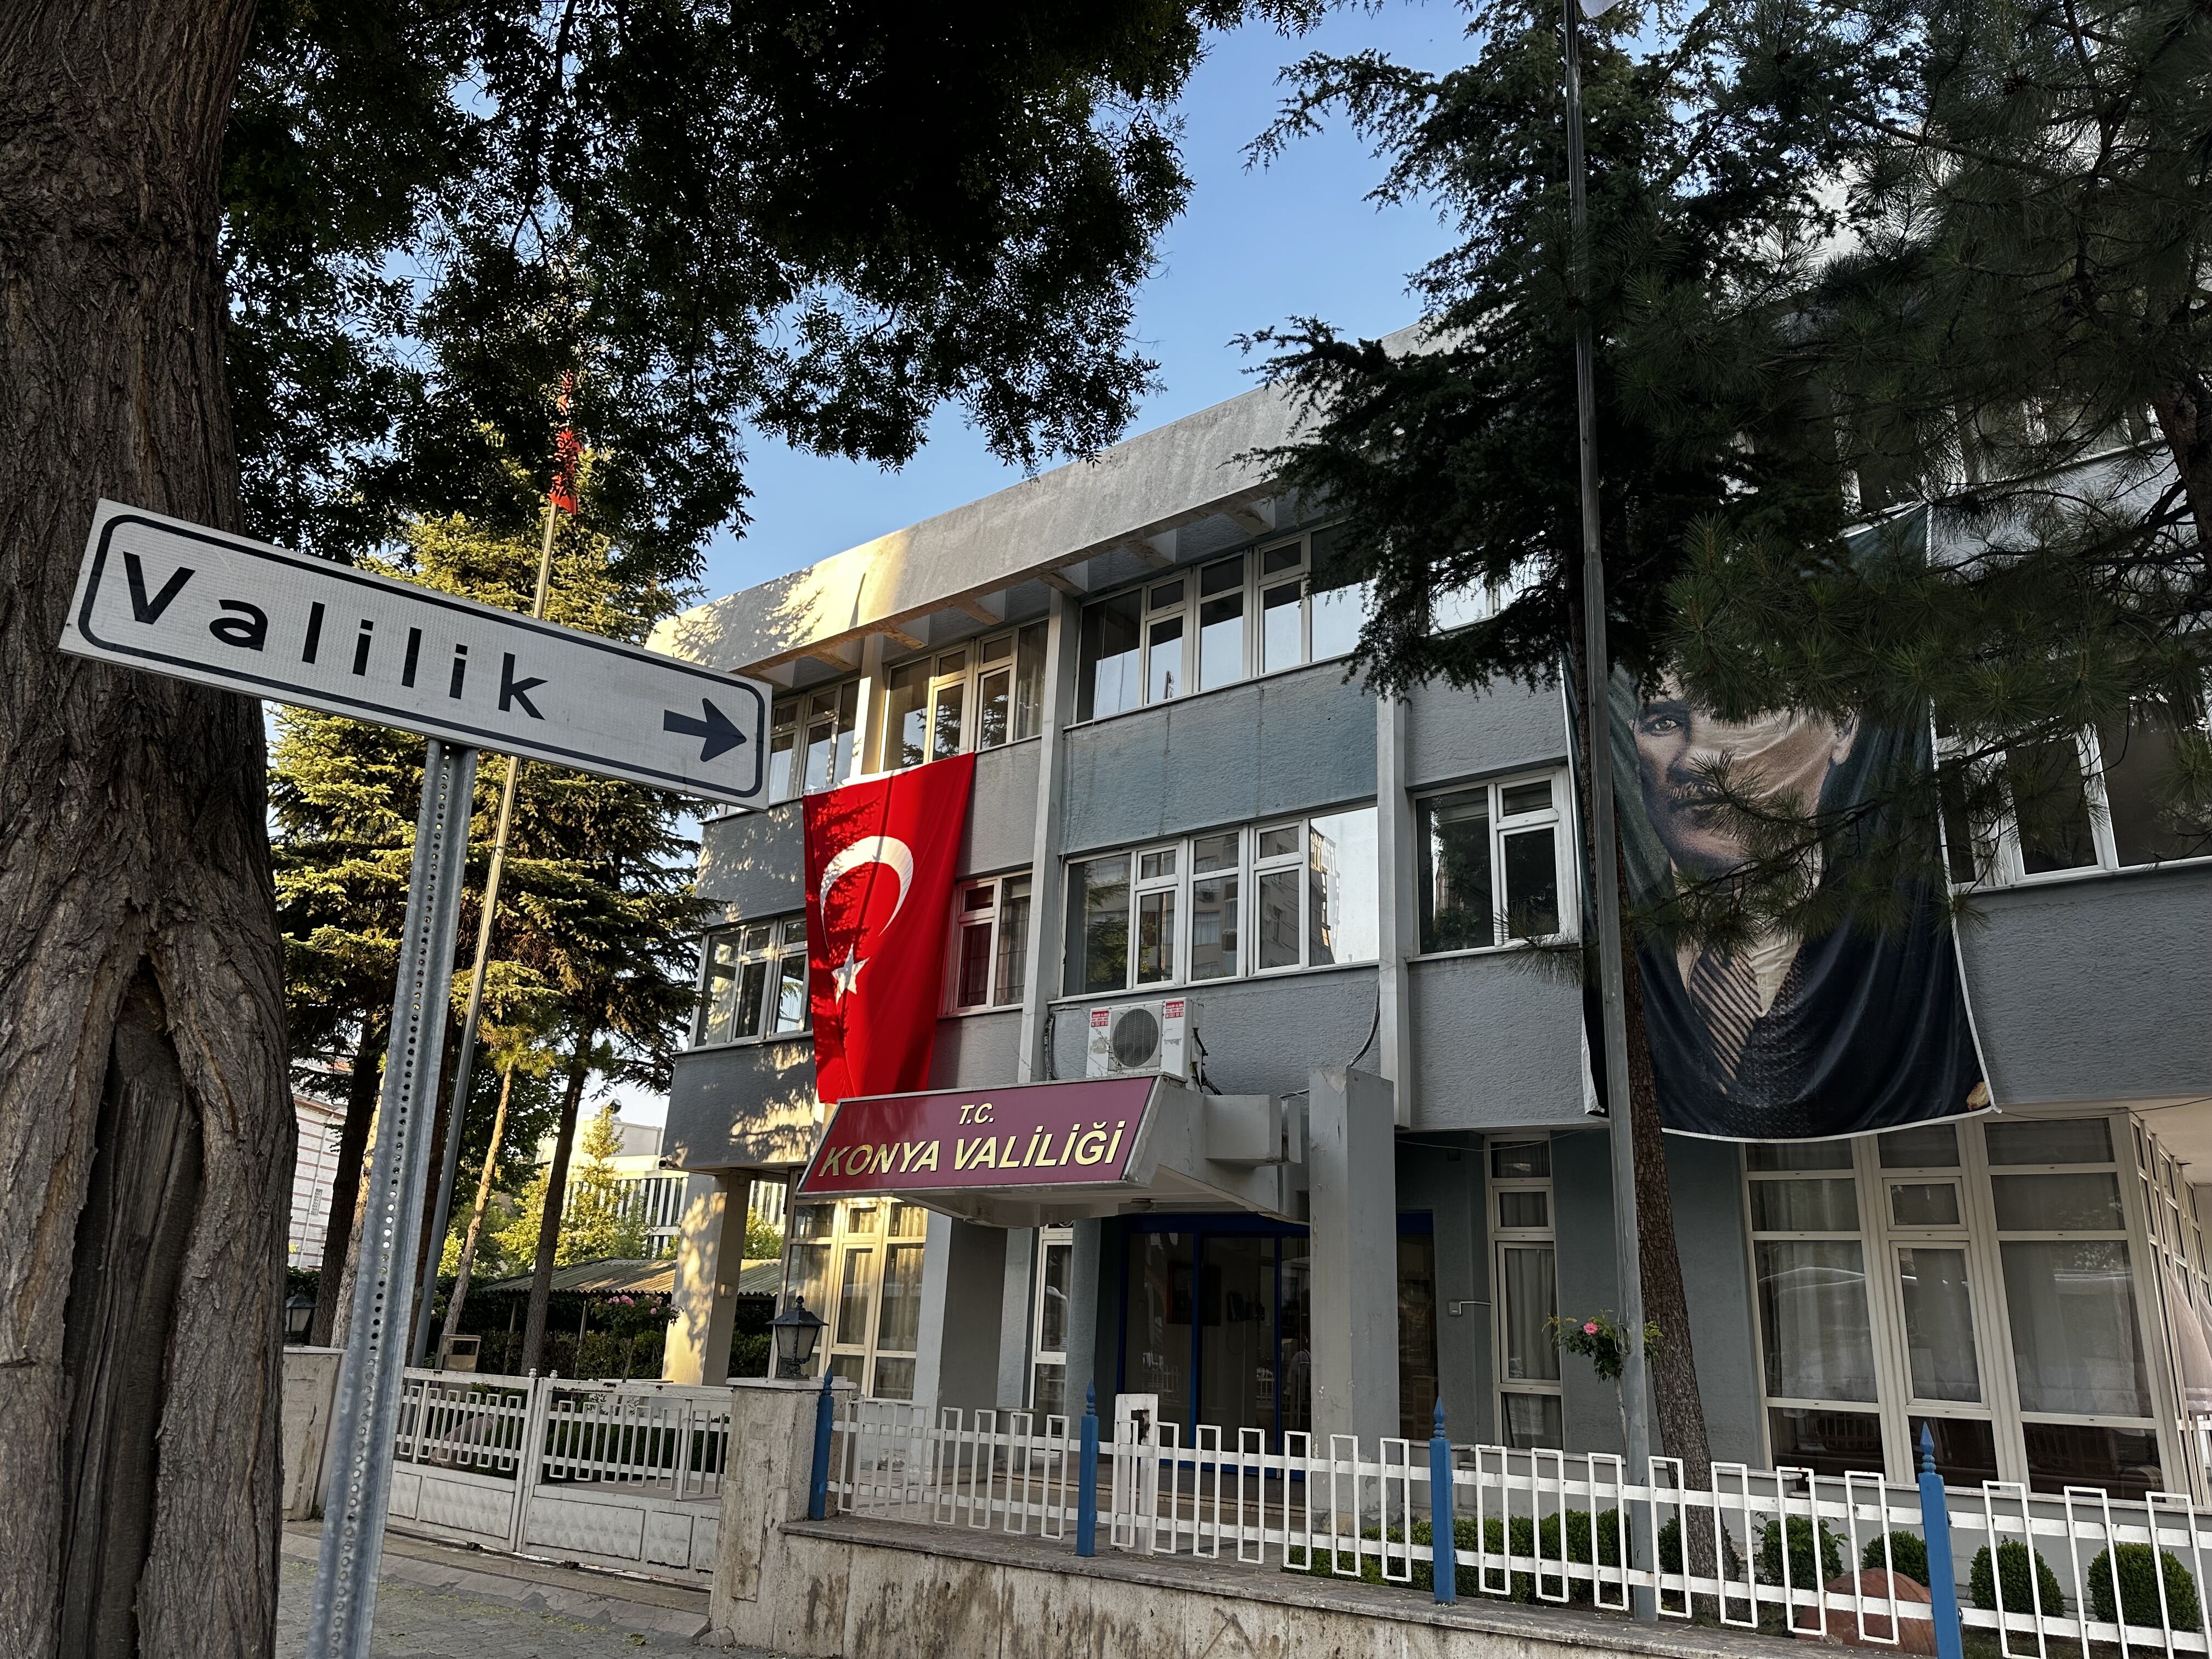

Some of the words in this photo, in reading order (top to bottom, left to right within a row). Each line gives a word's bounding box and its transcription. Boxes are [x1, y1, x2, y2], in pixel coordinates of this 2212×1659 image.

[123, 551, 549, 720] Valilik
[958, 1103, 995, 1125] T.C.
[819, 1141, 940, 1177] KONYA
[953, 1120, 1126, 1171] VALİLİĞİ
